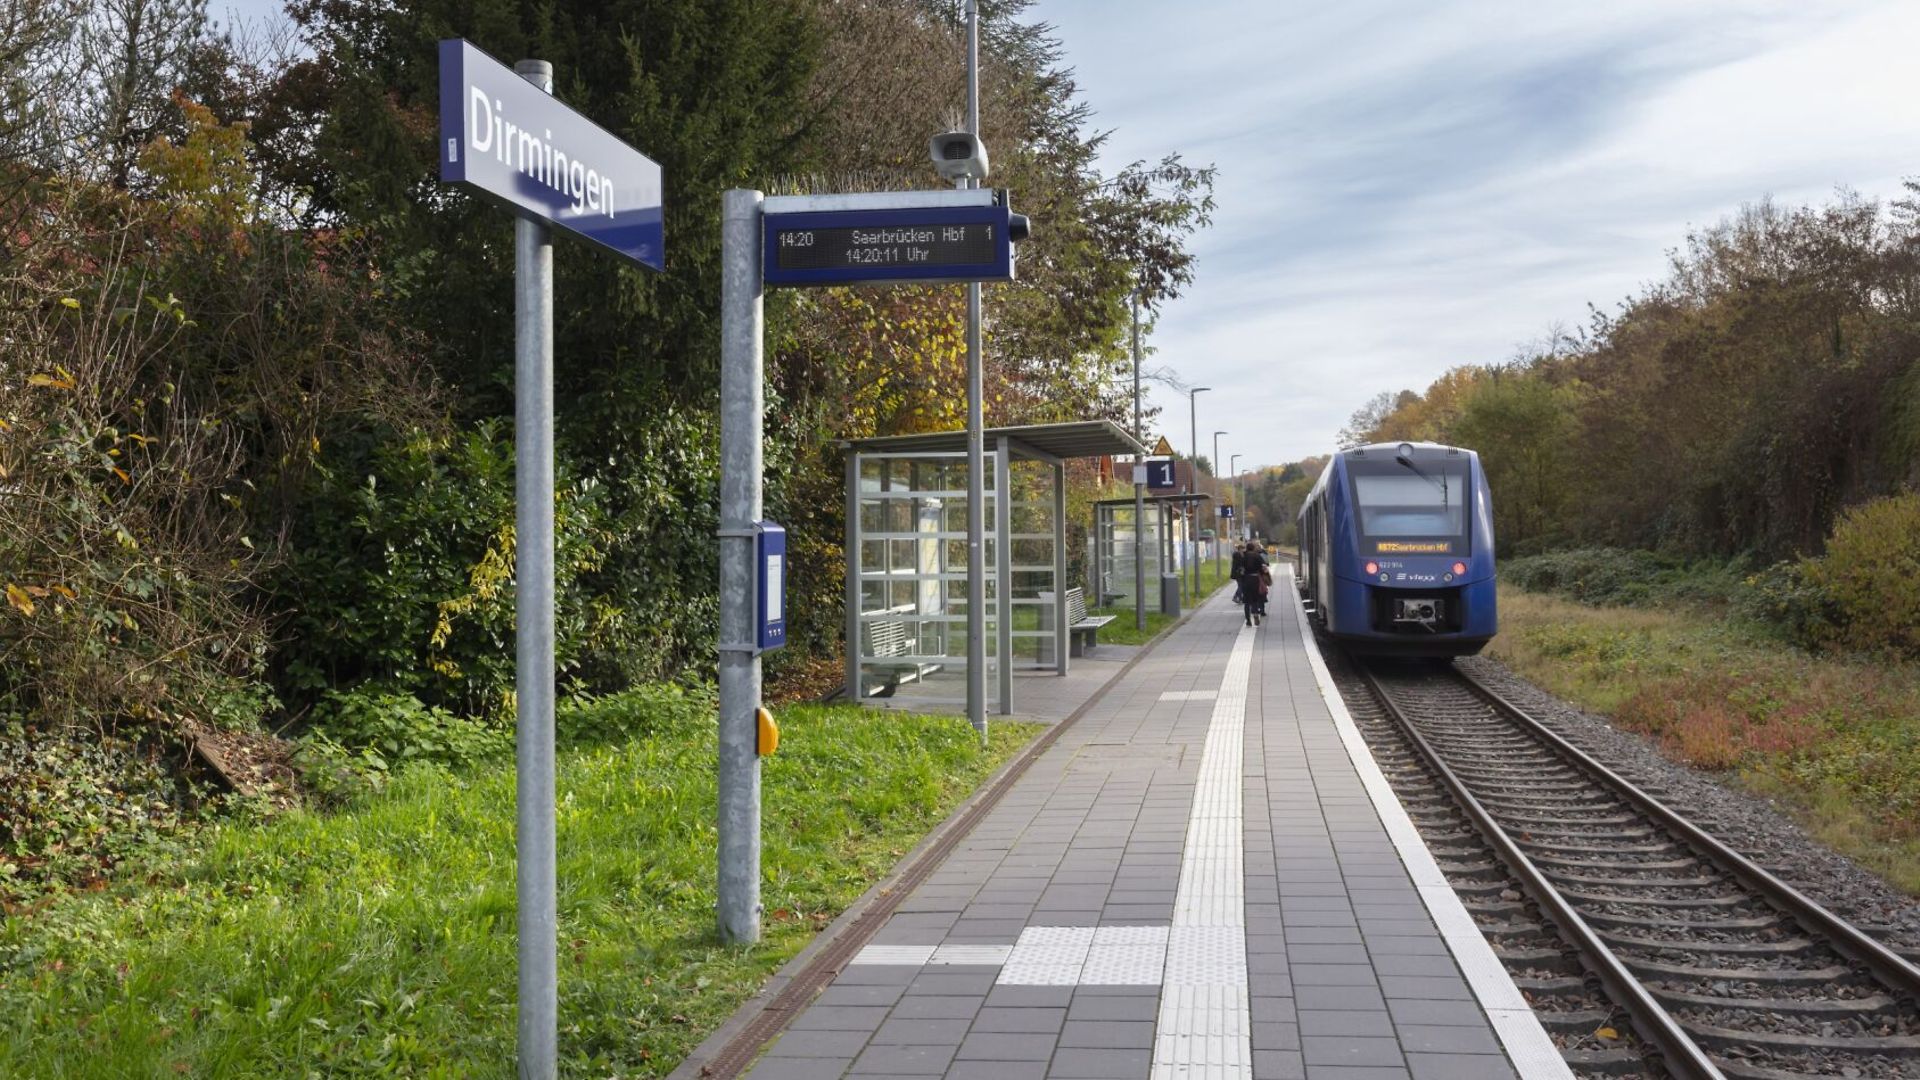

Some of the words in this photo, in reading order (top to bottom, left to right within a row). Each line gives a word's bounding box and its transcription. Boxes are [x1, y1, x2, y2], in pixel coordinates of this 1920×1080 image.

[471, 85, 614, 219] Dirmingen
[779, 232, 814, 247] 14:20
[852, 229, 935, 245] Saarbrücken
[942, 226, 965, 241] Hbf
[985, 225, 993, 240] 1
[846, 249, 899, 263] 14:20:11
[907, 247, 930, 261] Uhr
[1161, 464, 1173, 485] 1
[1226, 507, 1232, 516] 1
